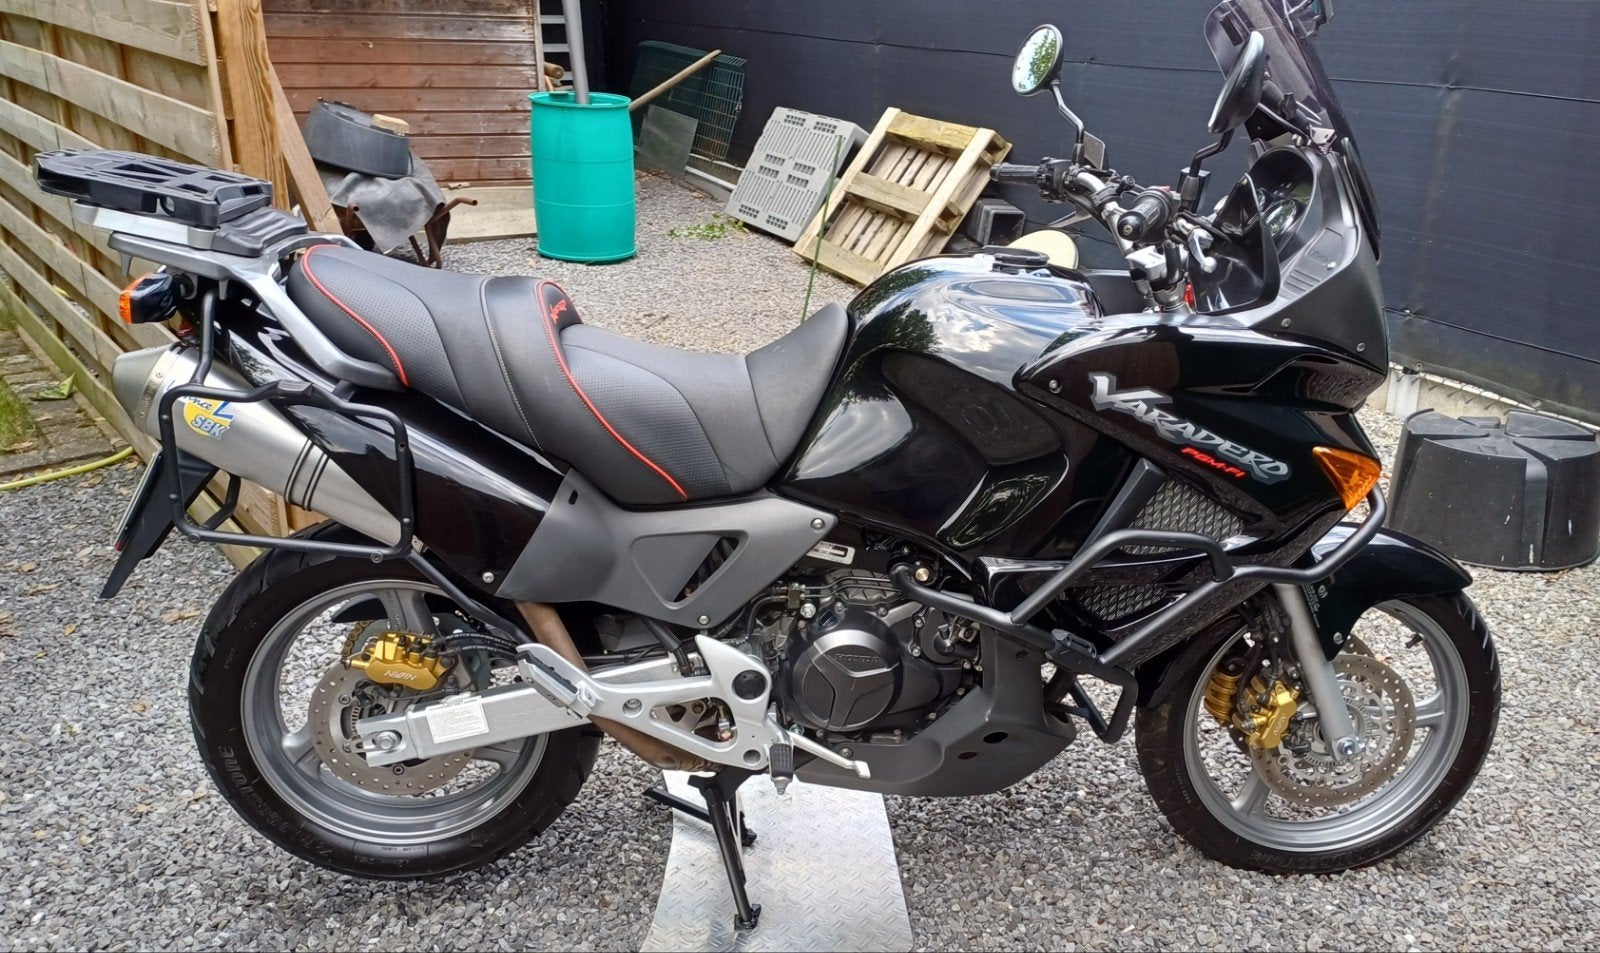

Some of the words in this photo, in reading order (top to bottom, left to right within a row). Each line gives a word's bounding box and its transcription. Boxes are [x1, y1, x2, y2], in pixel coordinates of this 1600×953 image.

[191, 415, 228, 438] SBK
[1092, 374, 1289, 480] VARADERO
[1181, 447, 1246, 477] PGM-FI
